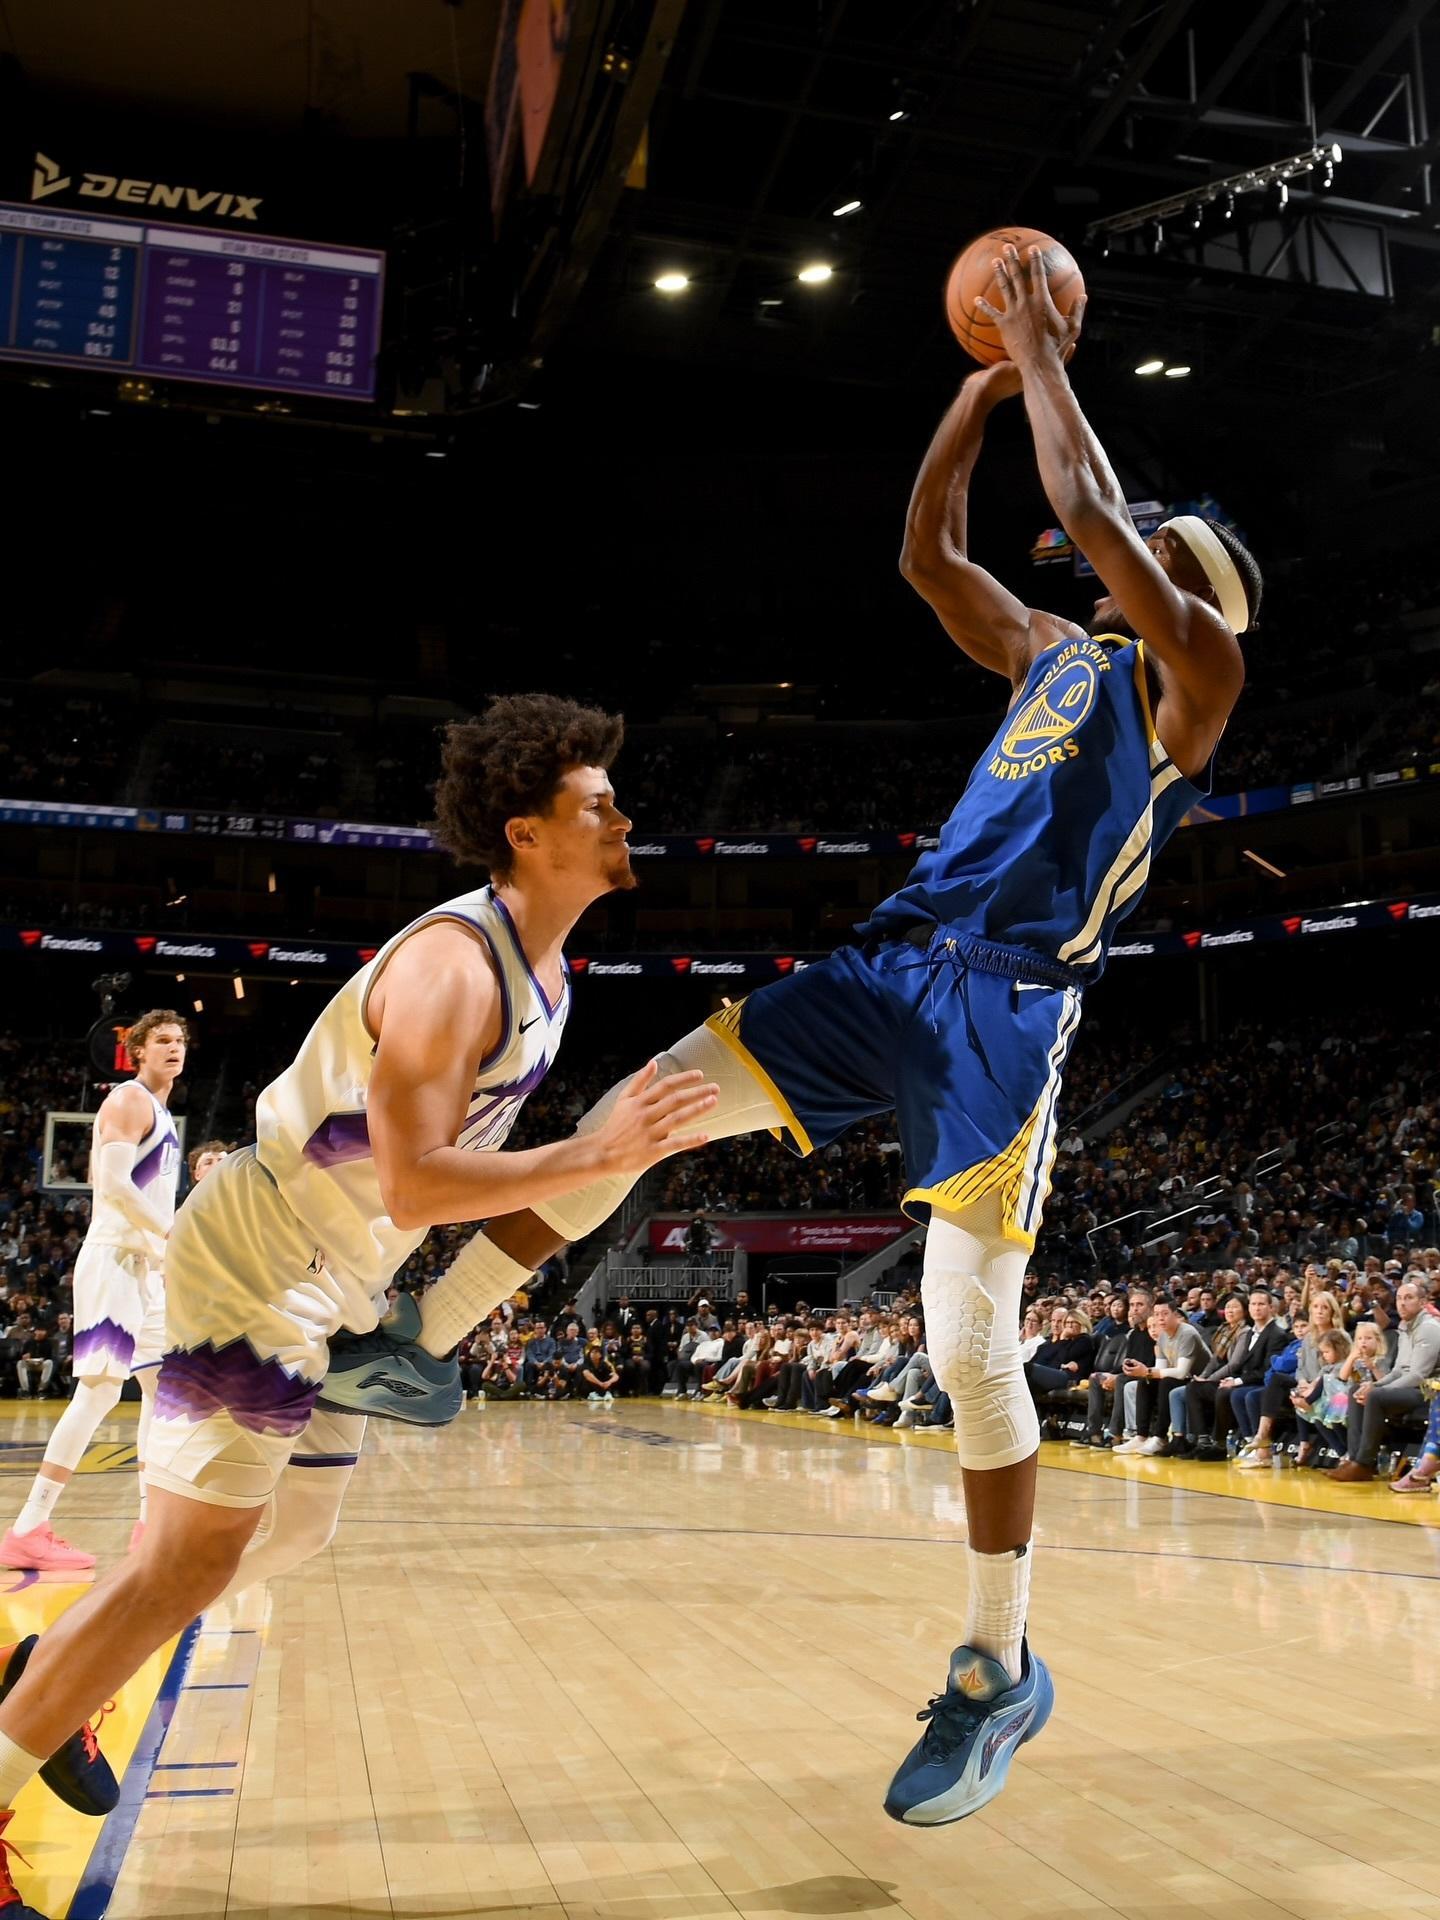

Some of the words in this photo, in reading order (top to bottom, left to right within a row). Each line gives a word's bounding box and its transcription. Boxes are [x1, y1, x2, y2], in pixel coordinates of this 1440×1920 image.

[78, 172, 263, 220] DENVIX
[1080, 642, 1111, 672] STATE
[1057, 680, 1088, 708] 10
[988, 738, 1080, 781] ARRIORS
[629, 843, 667, 855] natics
[714, 841, 769, 854] Fanatics
[816, 841, 871, 853] Fanatics
[1301, 915, 1358, 934] Fanatics
[40, 934, 103, 951] Fanatics
[1201, 930, 1254, 947] Fanatics
[155, 941, 216, 957] Fanatics
[268, 947, 328, 963] Fanatics
[1107, 942, 1155, 956] anatics
[588, 961, 643, 974] Fanatics
[690, 960, 746, 974] Fanatics
